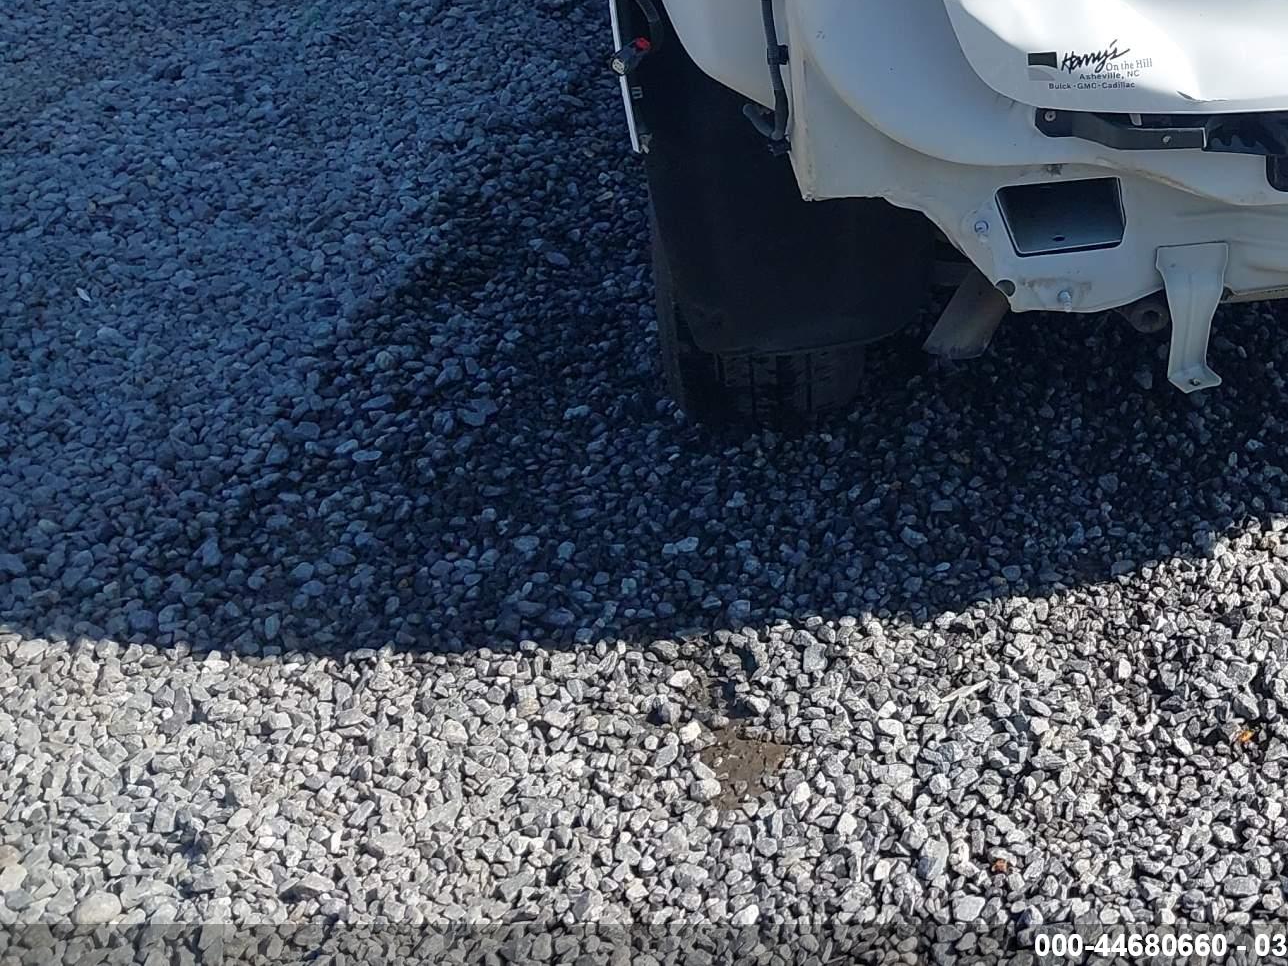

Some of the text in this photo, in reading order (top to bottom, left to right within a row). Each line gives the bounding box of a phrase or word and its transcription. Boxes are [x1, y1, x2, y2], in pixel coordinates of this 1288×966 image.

[1061, 39, 1153, 74] Harry's On the Hill
[1079, 72, 1125, 80] Asheville,
